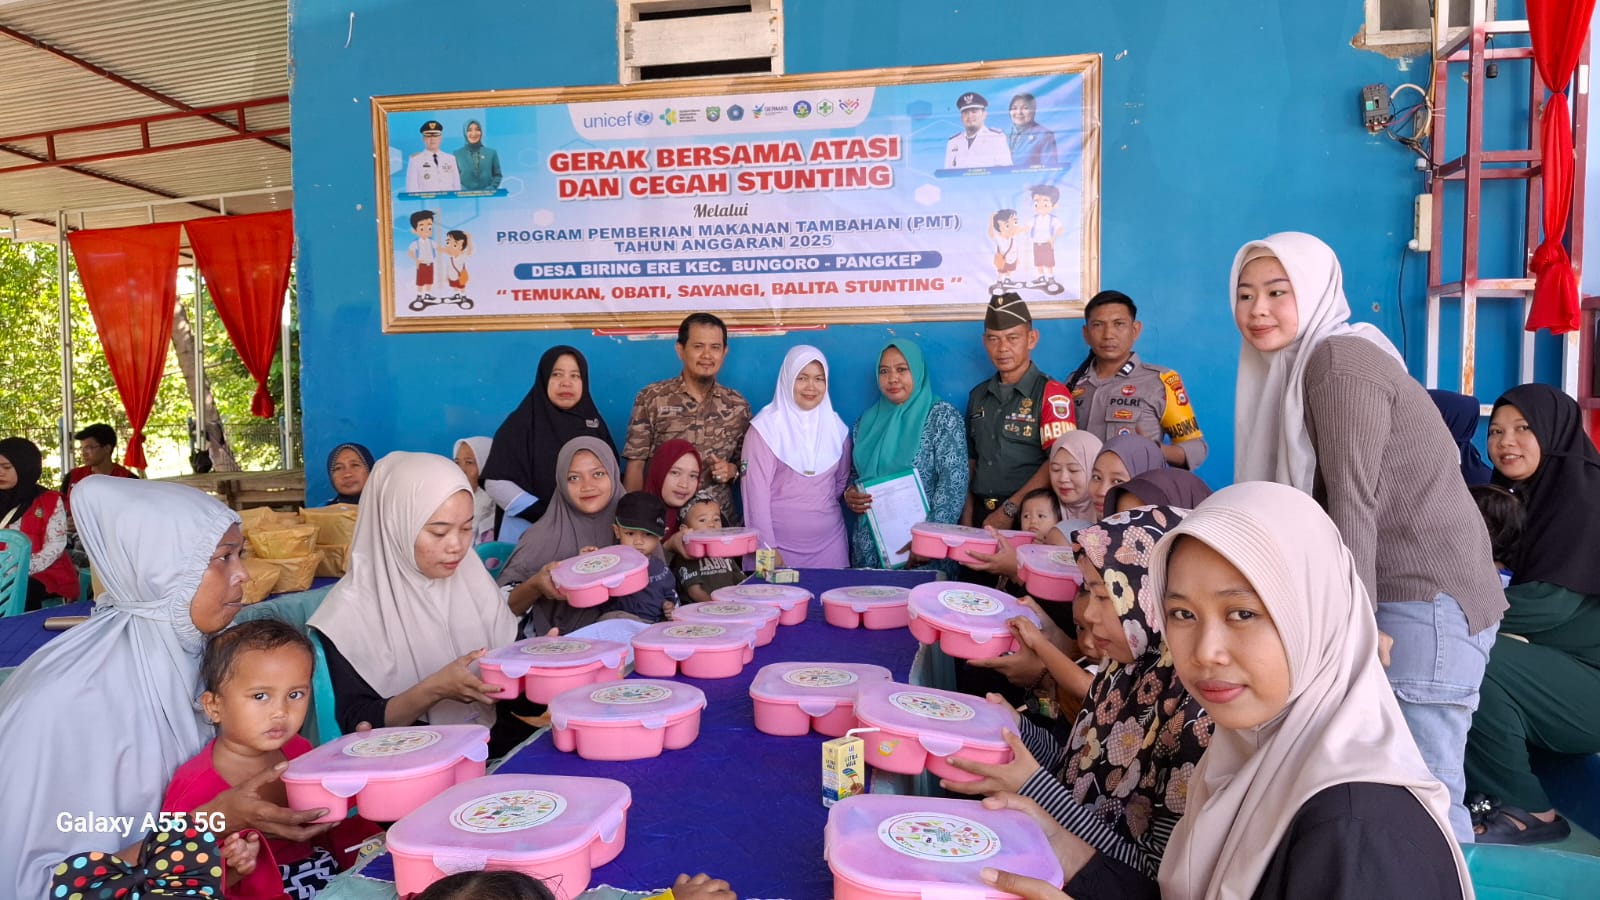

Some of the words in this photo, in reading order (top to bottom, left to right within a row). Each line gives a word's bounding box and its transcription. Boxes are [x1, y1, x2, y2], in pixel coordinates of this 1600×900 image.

[583, 111, 632, 128] unicef
[549, 150, 648, 173] GERAK
[656, 142, 803, 168] BERSAMA
[810, 137, 898, 161] ATASI
[559, 177, 619, 198] DAN
[629, 173, 727, 196] CEGAH
[737, 165, 890, 192] STUNTING
[693, 202, 748, 218] Melalui
[496, 229, 582, 242] PROGRAM
[588, 225, 692, 240] PEMBERIAN
[699, 222, 789, 237] MAKANAN
[796, 218, 900, 233] TAMBAHAN
[907, 215, 960, 232] (PMT)
[614, 240, 676, 253] TAHUN
[681, 236, 784, 251] ANGGARAN
[790, 234, 833, 248] 2025
[531, 265, 577, 278] DESA
[581, 262, 641, 277] BIRING
[646, 261, 681, 275] ERE
[685, 261, 726, 274] KEC.
[732, 257, 819, 272] BUNGORO
[836, 254, 922, 269] PANGKEP
[511, 287, 605, 302] TEMUKAN,
[611, 285, 672, 300] OBATI,
[678, 283, 765, 299] SAYANGI,
[771, 280, 839, 296] BALITA
[845, 278, 945, 293] STUNTING
[1110, 398, 1140, 407] POLRI
